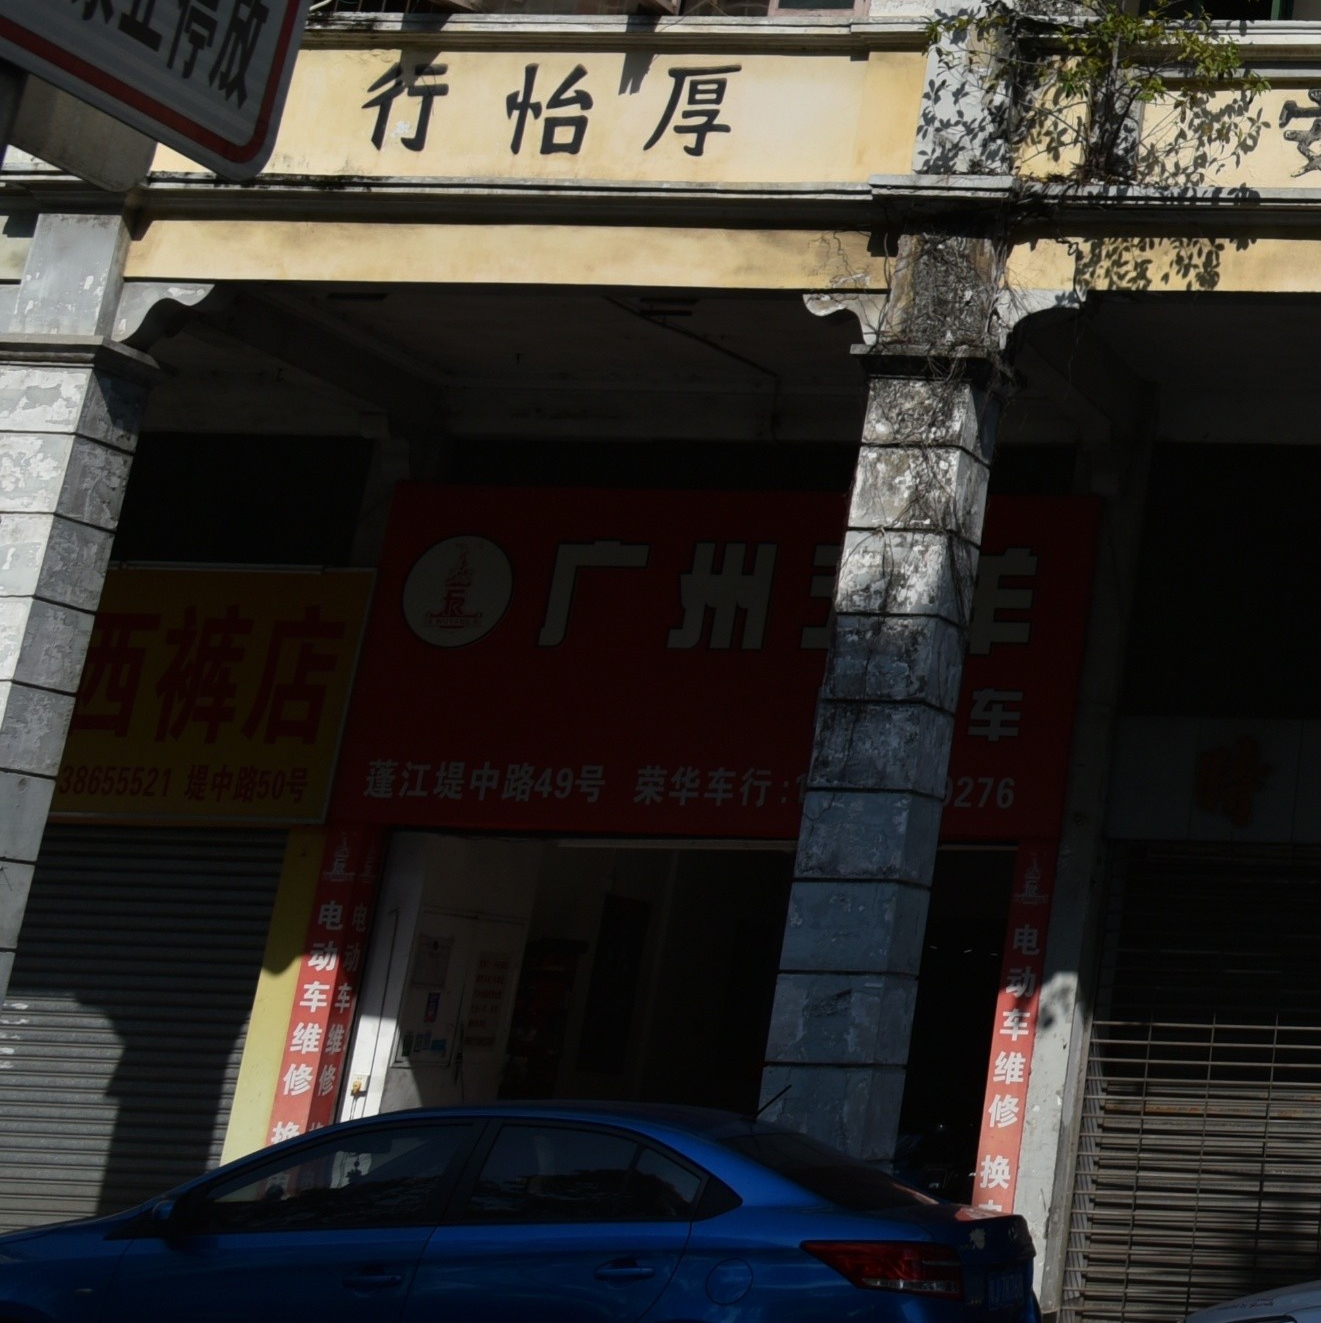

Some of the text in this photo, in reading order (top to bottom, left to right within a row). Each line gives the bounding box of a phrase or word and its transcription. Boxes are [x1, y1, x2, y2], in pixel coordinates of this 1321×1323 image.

[283, 900, 344, 1096] 电动车维修
[988, 923, 1040, 1129] 电动车维修
